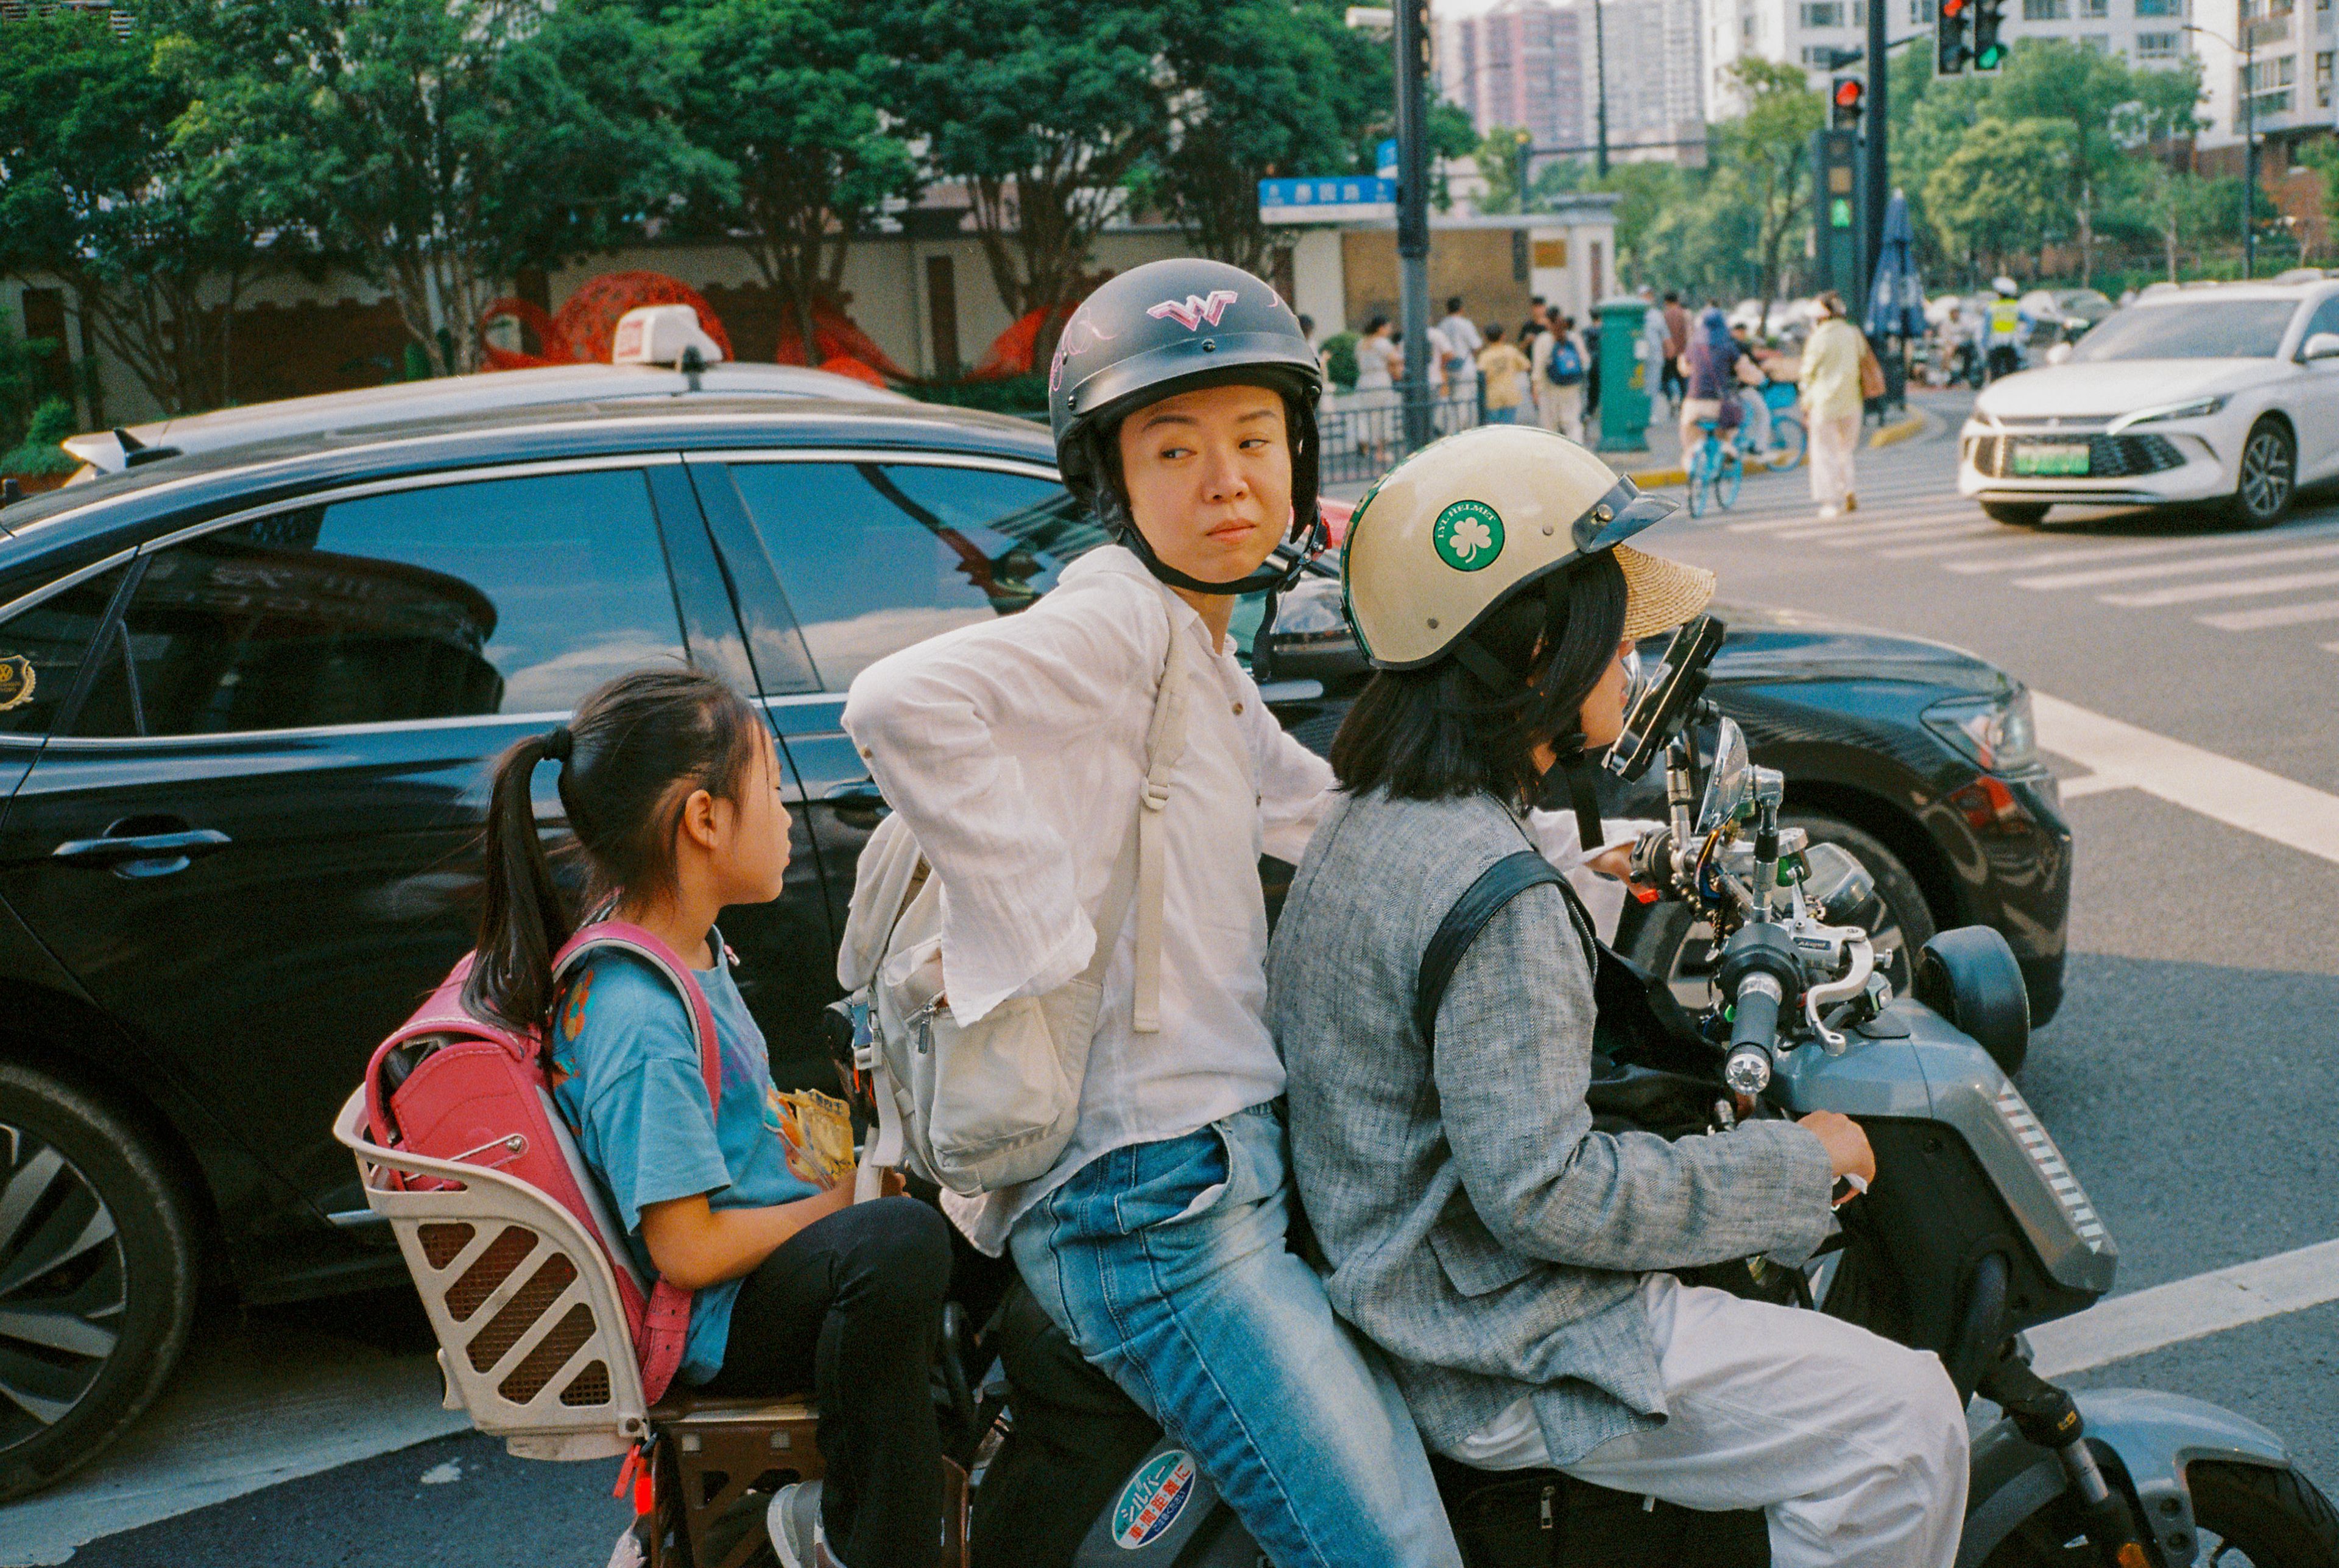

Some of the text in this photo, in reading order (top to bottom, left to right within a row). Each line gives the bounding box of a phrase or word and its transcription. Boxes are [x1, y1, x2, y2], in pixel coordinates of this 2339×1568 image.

[1438, 504, 1496, 538] LYL HELMET
[1121, 1465, 1166, 1522] シルバー
